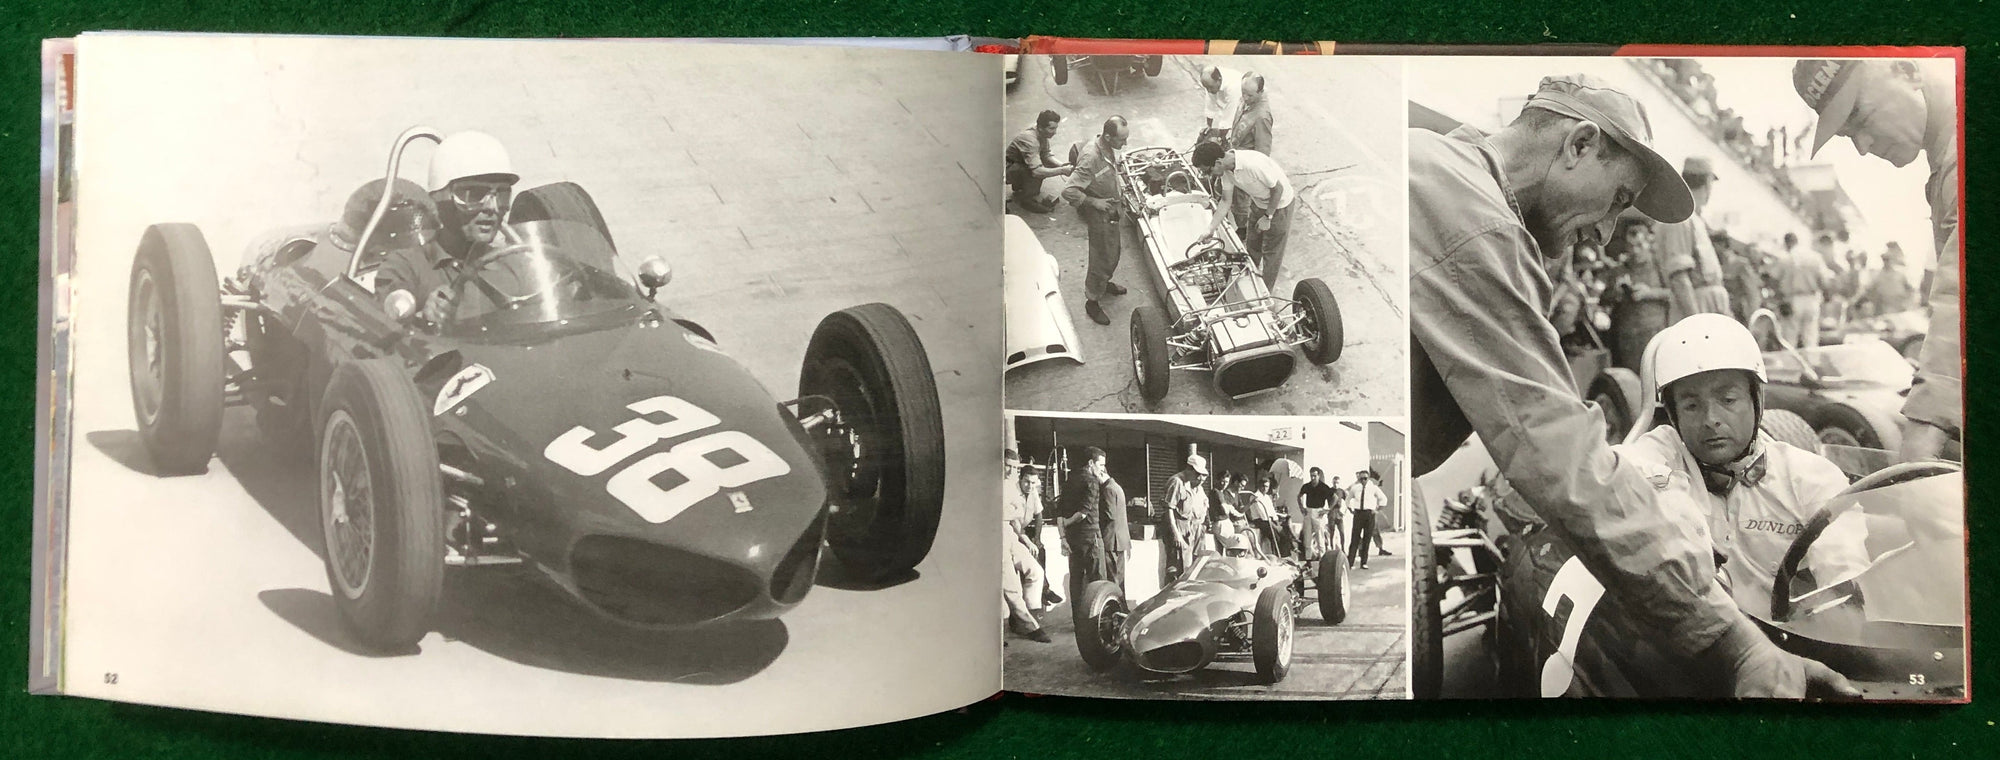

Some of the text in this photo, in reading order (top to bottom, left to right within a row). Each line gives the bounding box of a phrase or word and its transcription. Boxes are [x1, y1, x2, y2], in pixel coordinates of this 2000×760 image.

[1275, 430, 1288, 439] 22
[543, 395, 791, 523] 38
[104, 672, 119, 685] 52
[1909, 673, 1925, 686] 53
